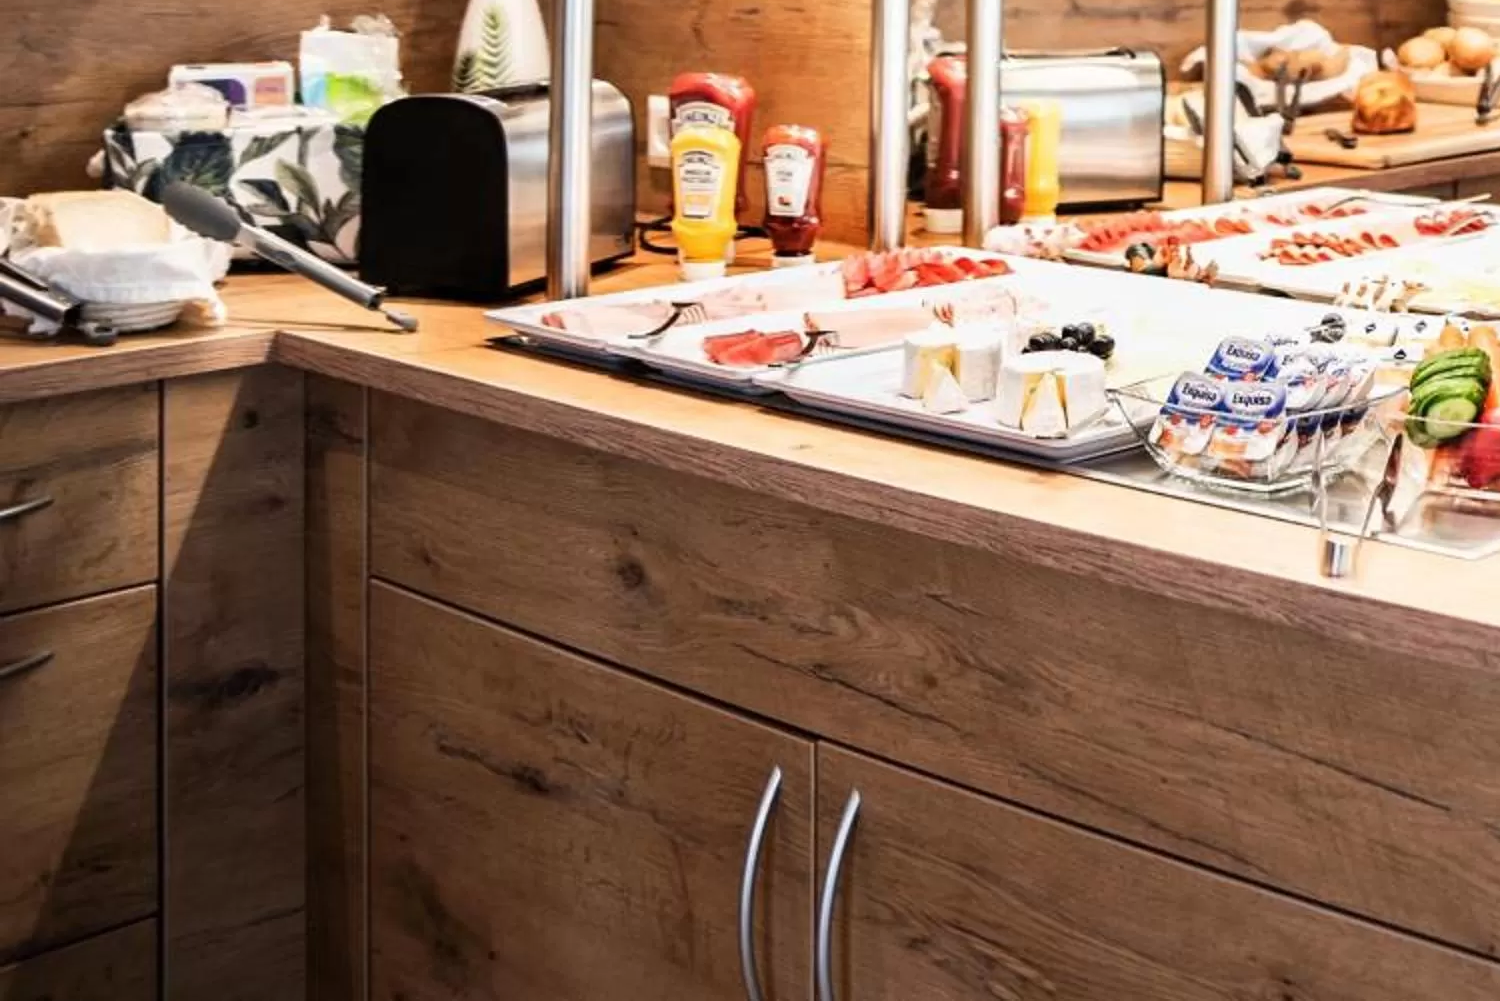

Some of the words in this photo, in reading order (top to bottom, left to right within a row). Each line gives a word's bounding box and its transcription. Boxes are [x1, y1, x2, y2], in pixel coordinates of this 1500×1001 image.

[1225, 343, 1262, 361] Exquisa
[1181, 381, 1218, 403] Exquisa
[1232, 390, 1272, 407] Exquisa
